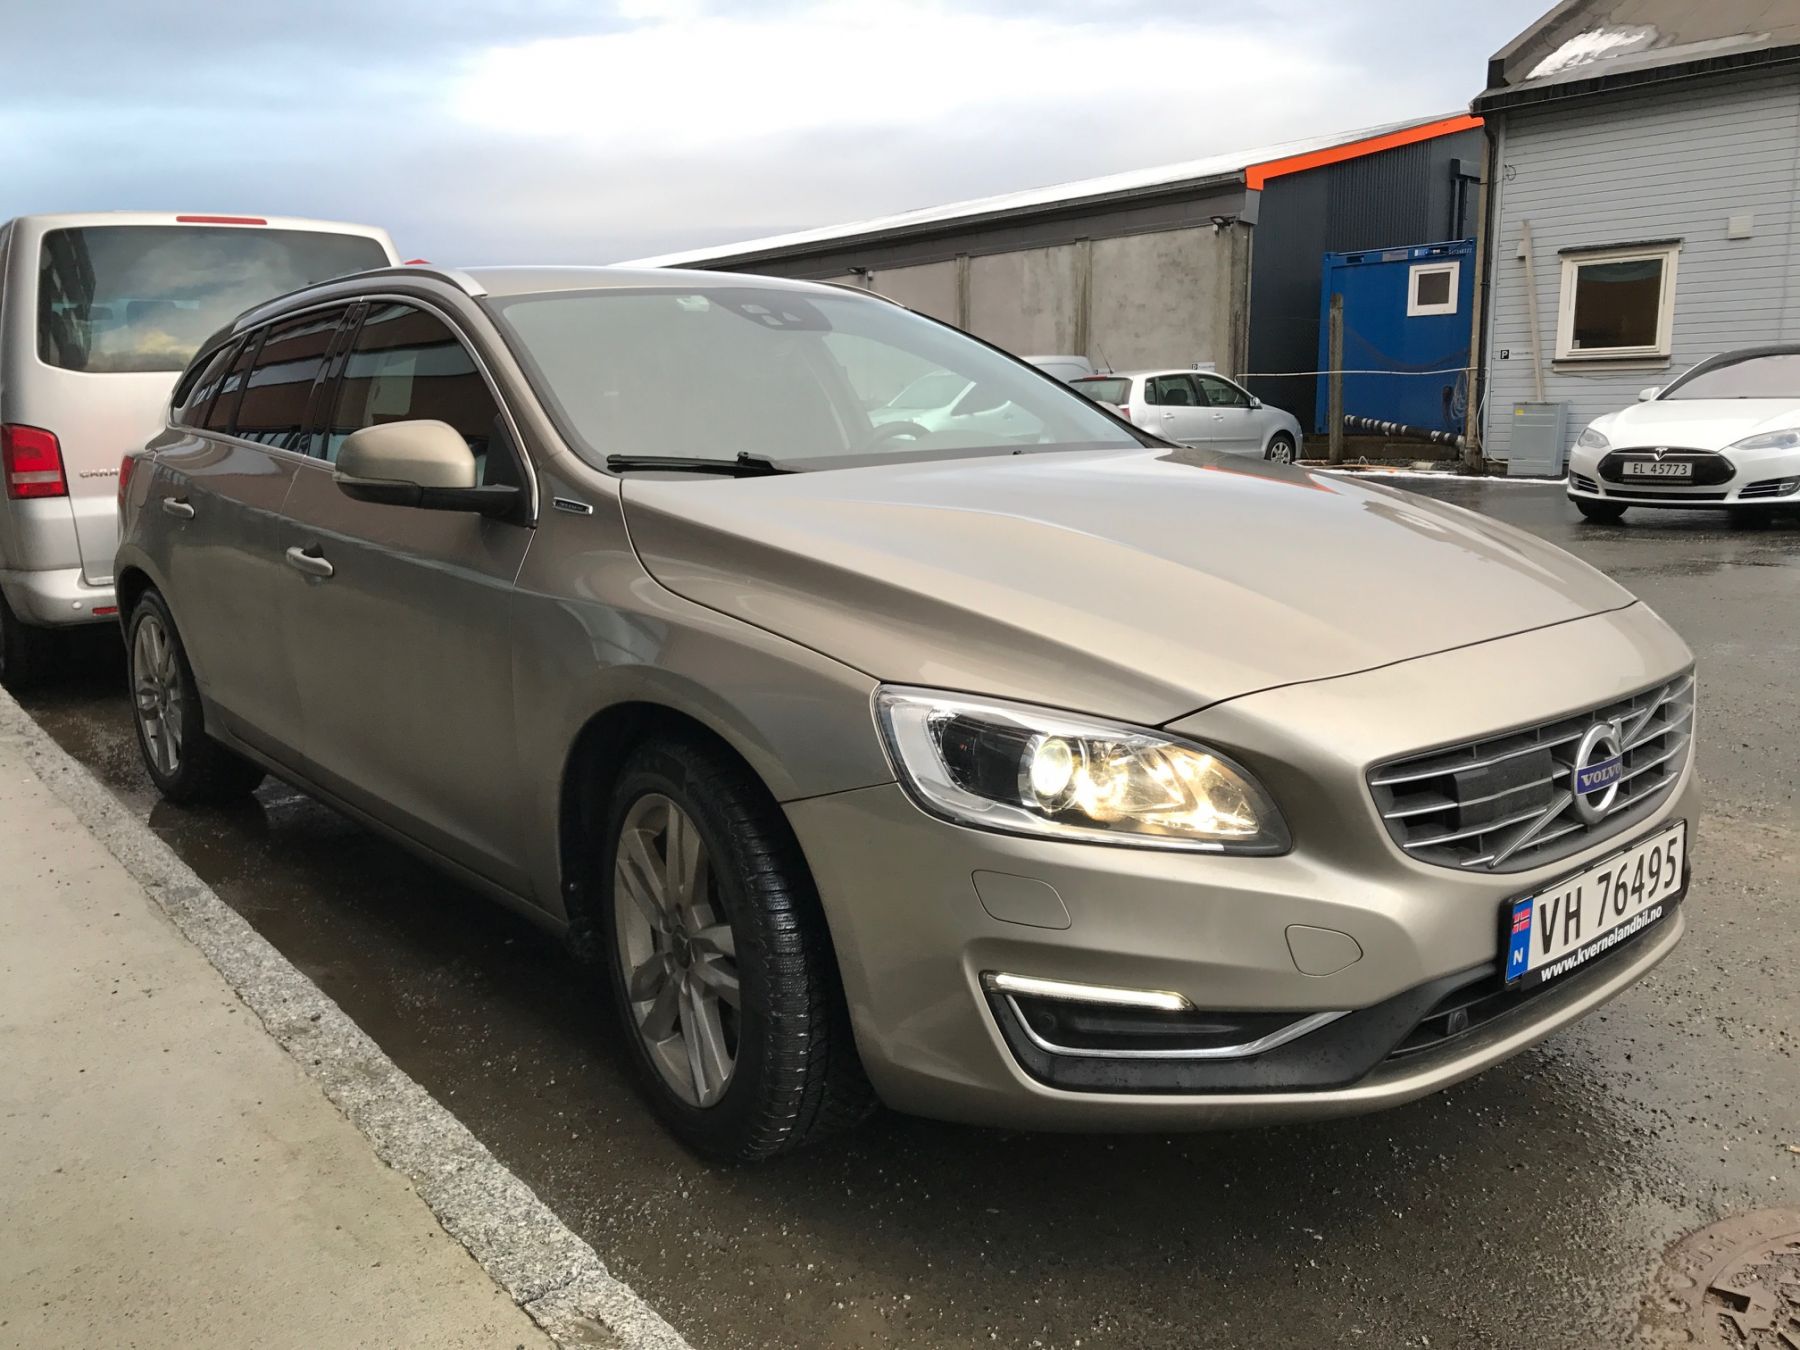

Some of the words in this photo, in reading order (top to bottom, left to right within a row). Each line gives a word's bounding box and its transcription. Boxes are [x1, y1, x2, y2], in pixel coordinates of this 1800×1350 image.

[1501, 350, 1509, 359] P
[1633, 463, 1645, 474] EL
[1650, 463, 1688, 475] 45773
[1581, 763, 1621, 787] VOLVO
[1539, 886, 1582, 956] VH
[1597, 836, 1678, 928] 76495
[1541, 905, 1662, 982] www.kvernelandbil.no
[1513, 947, 1523, 965] N
